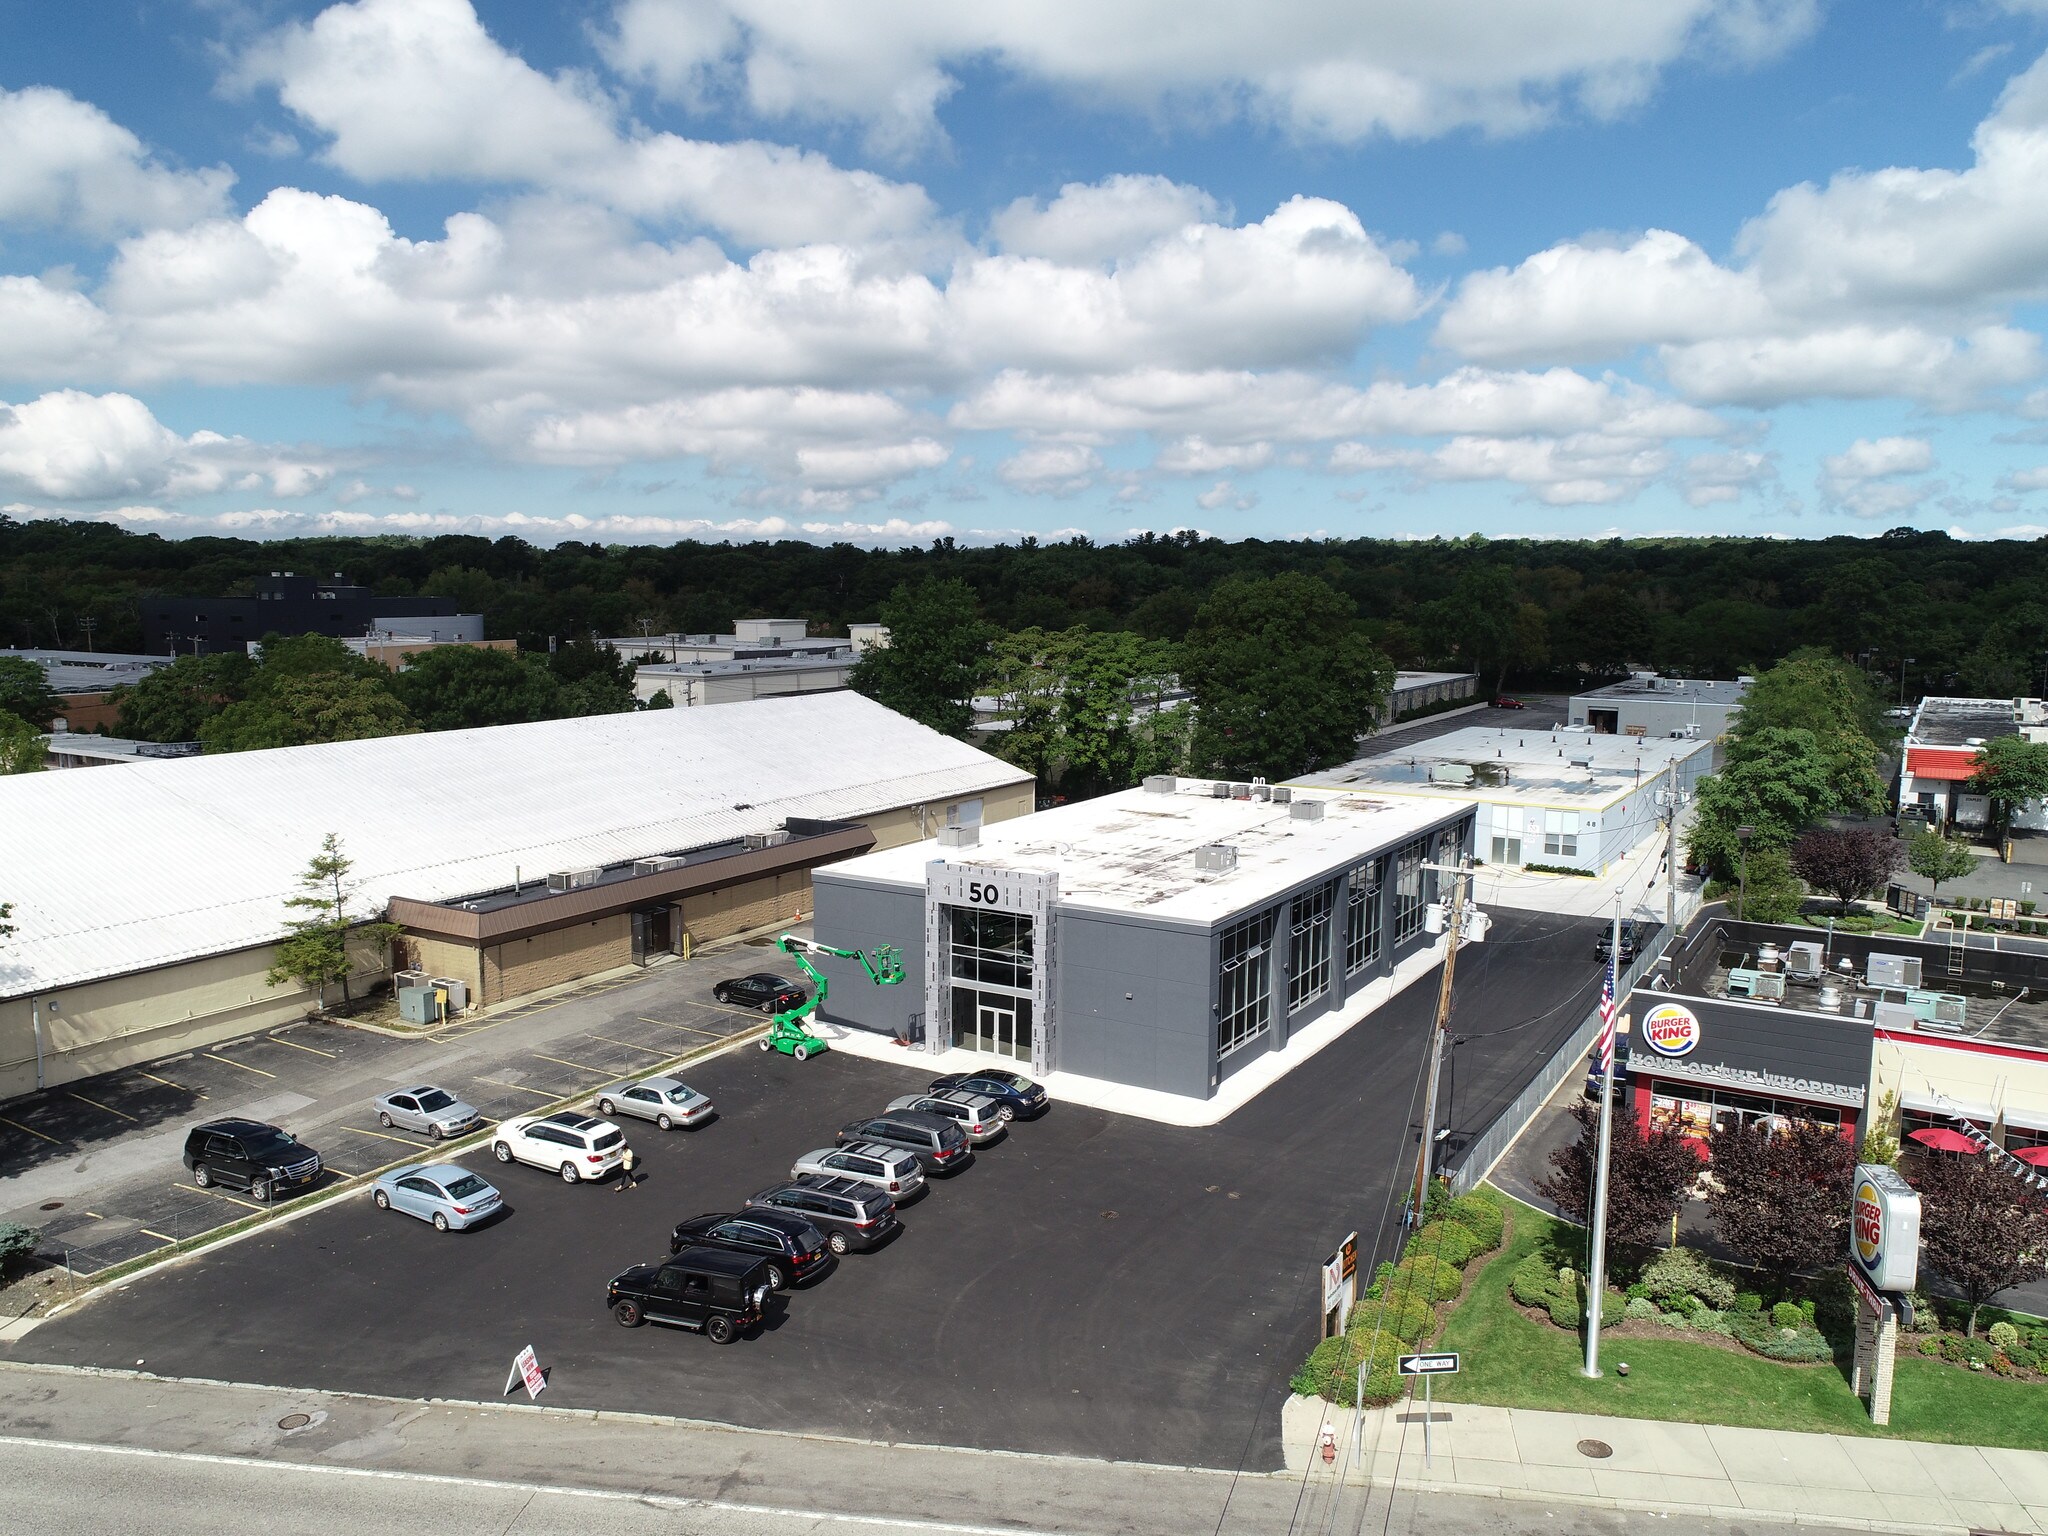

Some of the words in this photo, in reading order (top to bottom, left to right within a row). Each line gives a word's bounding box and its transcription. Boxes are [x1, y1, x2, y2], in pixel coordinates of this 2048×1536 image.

[969, 882, 999, 905] 50
[1650, 1017, 1690, 1030] BURGER
[1652, 1025, 1692, 1041] KING
[1629, 1052, 1682, 1072] HOME
[1688, 1061, 1713, 1076] OF
[1717, 1066, 1757, 1084] THE
[1764, 1073, 1863, 1101] WHOPPER
[1848, 1267, 1881, 1315] DRIVE-THRU
